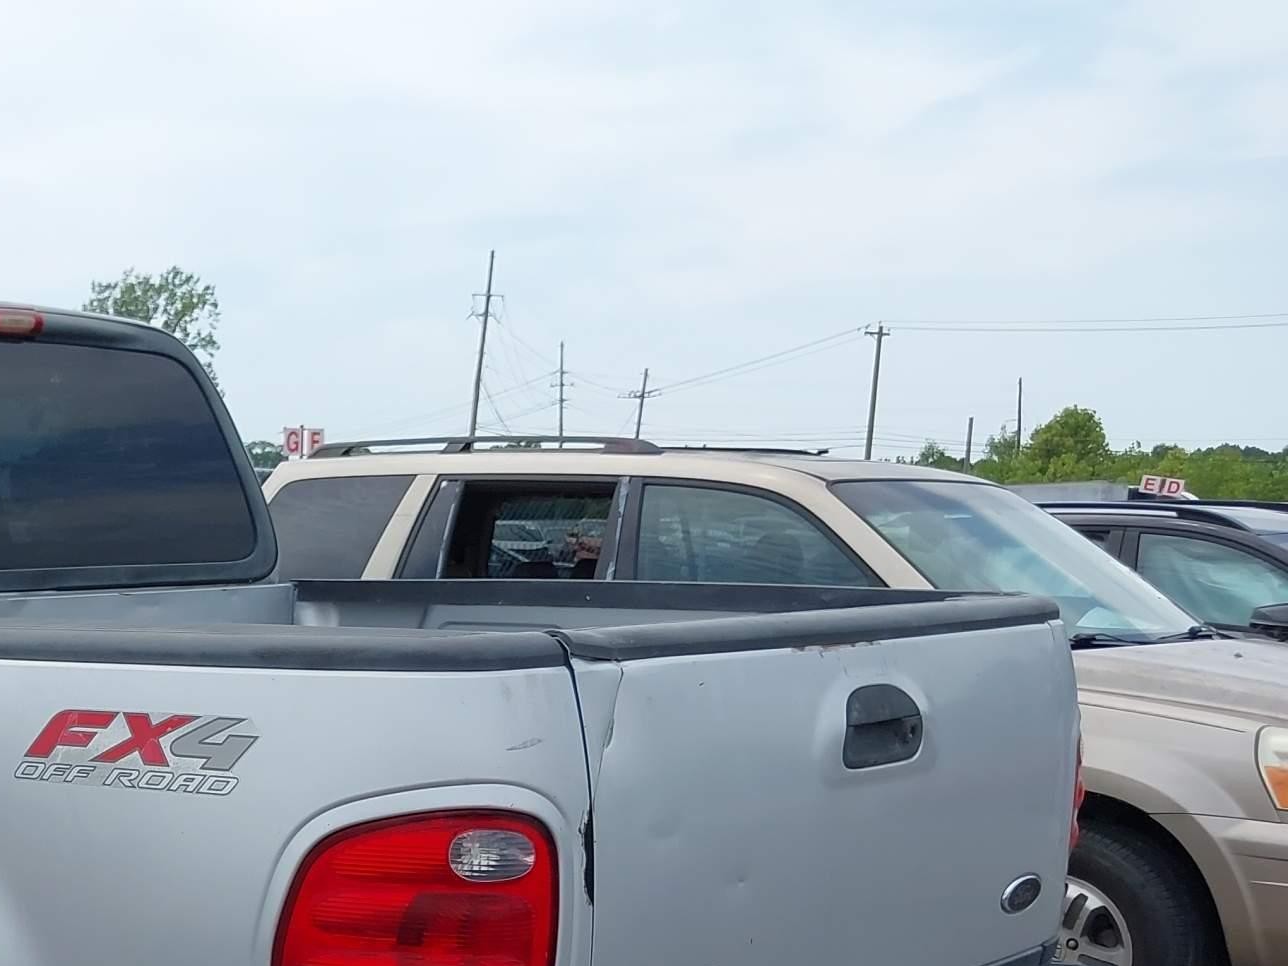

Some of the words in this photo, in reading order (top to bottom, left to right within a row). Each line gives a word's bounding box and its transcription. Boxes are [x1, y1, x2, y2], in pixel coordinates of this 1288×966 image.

[287, 431, 299, 453] G
[1144, 478, 1157, 491] E
[1167, 481, 1181, 494] D
[23, 709, 259, 771] FX4
[14, 761, 96, 782] OFF
[103, 767, 239, 796] ROAD
